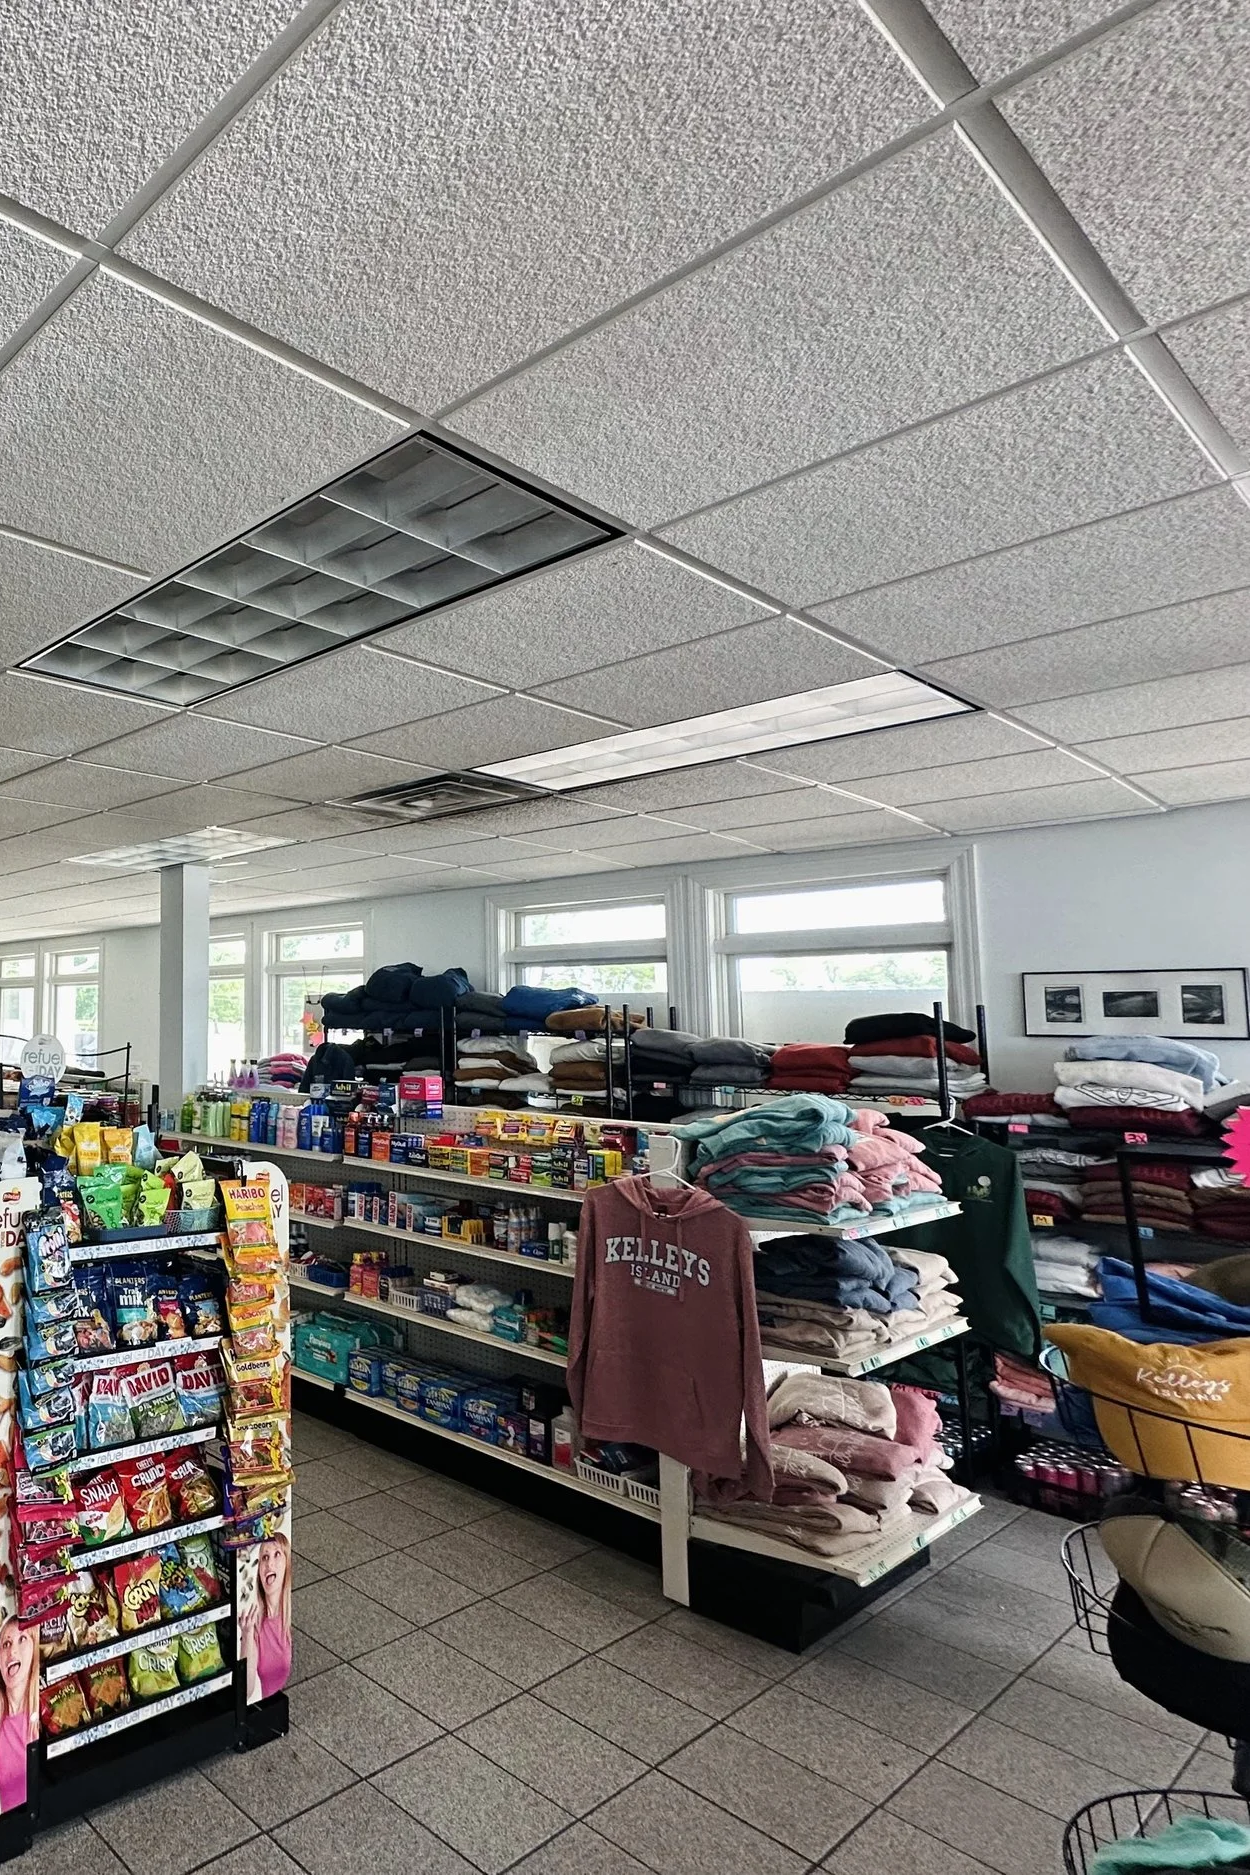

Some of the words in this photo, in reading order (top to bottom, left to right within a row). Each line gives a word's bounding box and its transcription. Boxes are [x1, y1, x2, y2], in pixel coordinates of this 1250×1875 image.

[24, 1049, 63, 1065] refuel
[334, 1082, 352, 1092] Advil
[228, 1187, 266, 1200] HARIBO
[235, 1202, 266, 1212] Peaches
[6, 1229, 26, 1247] DA
[155, 1239, 174, 1249] DAY
[605, 1236, 711, 1286] KELLEYS
[114, 1277, 146, 1285] PLANTERS
[106, 1354, 133, 1366] refuel
[147, 1348, 170, 1359] DAY
[235, 1359, 272, 1372] Goldbears
[126, 1366, 171, 1397] DAVID
[181, 1368, 226, 1391] DAVID
[1136, 1367, 1233, 1395] Kelleys
[1153, 1387, 1223, 1402] ISLAND
[425, 1397, 452, 1411] TAMPAX
[464, 1410, 492, 1424] TAMPAX
[97, 1450, 124, 1464] refuel
[138, 1442, 159, 1453] DAY
[112, 1541, 138, 1555] refuel
[153, 1531, 174, 1544] DAY
[123, 1579, 157, 1611] CORN
[113, 1637, 140, 1655] refuel
[155, 1626, 175, 1641] DAY
[182, 1626, 217, 1655] CRISPS
[138, 1652, 179, 1673] CRISPS
[114, 1710, 140, 1729] refuel
[156, 1696, 176, 1712] DAY
